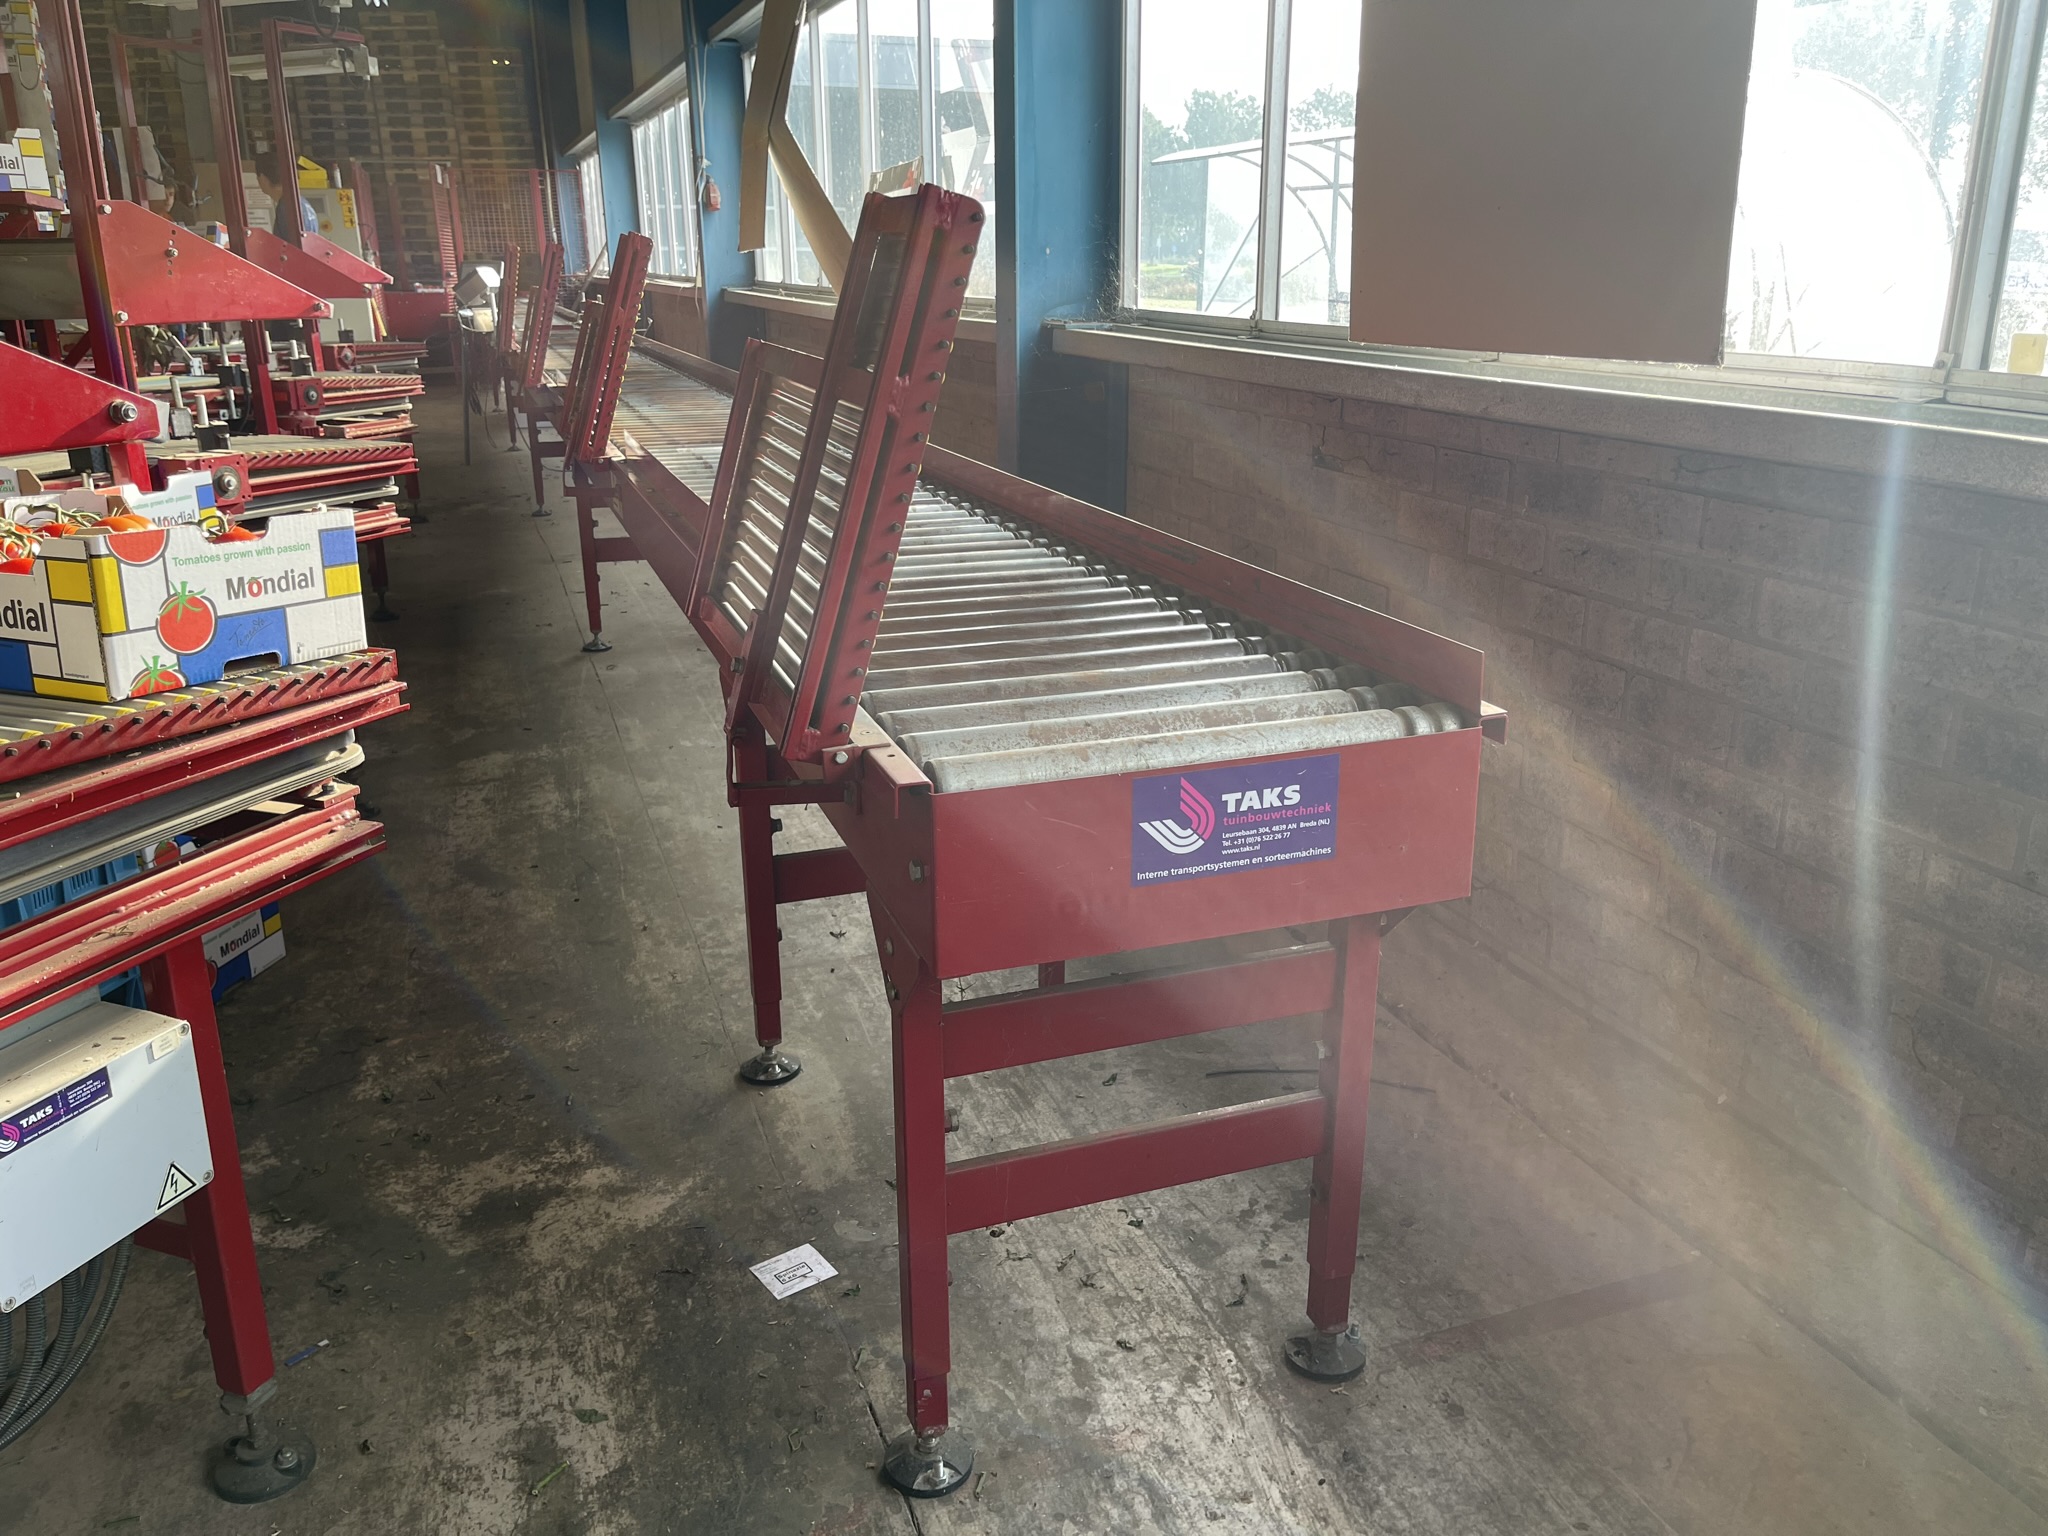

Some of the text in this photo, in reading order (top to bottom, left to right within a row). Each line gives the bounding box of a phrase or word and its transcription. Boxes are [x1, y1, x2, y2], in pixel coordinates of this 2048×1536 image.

[172, 542, 310, 567] Tomatoes grown with passion
[225, 567, 315, 600] Mondial
[0, 599, 48, 632] dial
[1222, 784, 1301, 813] TAKS
[1223, 802, 1331, 826] tuinbouwtechniek
[1222, 828, 1257, 839] Leursebaan
[1272, 824, 1286, 832] 4839
[1300, 820, 1317, 828] Breda
[1318, 818, 1330, 826] (NL)
[1137, 846, 1331, 880] Interne transportsystemen en sorteermachines
[1222, 844, 1260, 855] www.taks.nl
[220, 923, 260, 958] Mondial
[19, 1104, 54, 1128] TAKS
